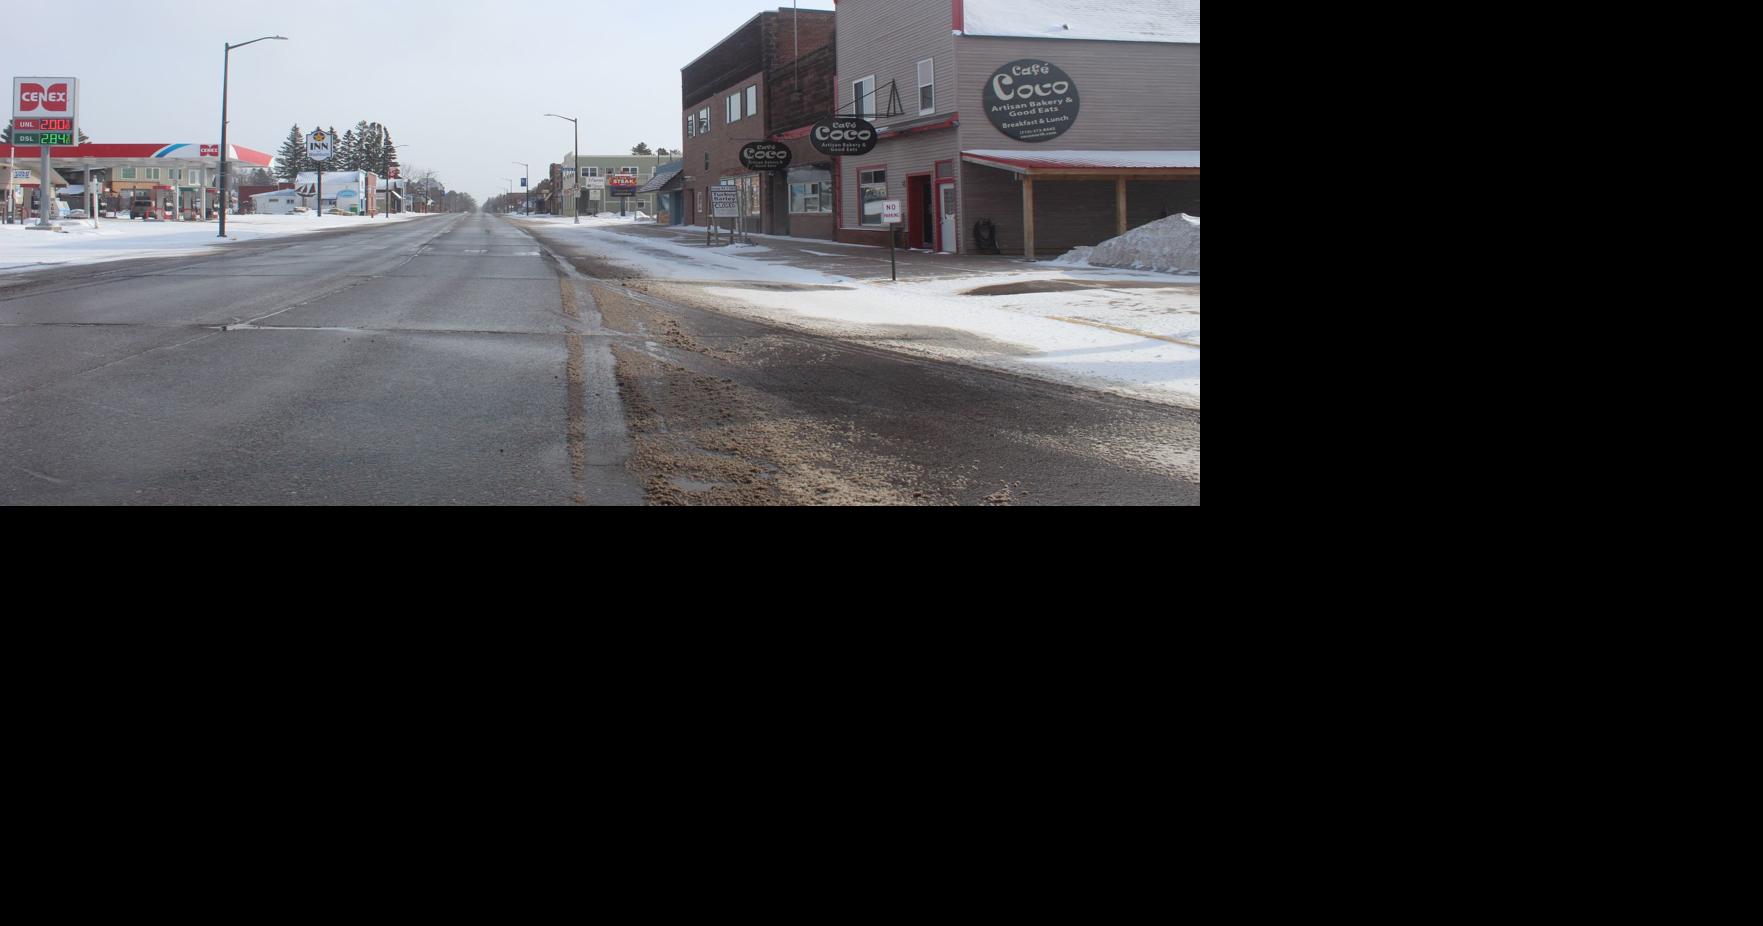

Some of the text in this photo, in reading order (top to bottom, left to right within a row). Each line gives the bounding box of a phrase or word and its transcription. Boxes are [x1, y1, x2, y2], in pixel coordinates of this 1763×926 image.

[1012, 63, 1049, 76] Café
[993, 73, 1068, 101] Coco
[21, 92, 66, 102] CENEX
[991, 102, 1027, 112] Artisan
[1029, 99, 1063, 109] Bakery
[1009, 106, 1058, 117] Good Eats
[1002, 119, 1038, 129] Breakfast
[1046, 115, 1069, 123] Lunch
[815, 125, 871, 141] Coco
[310, 142, 329, 151] INN
[743, 147, 788, 159] Coco
